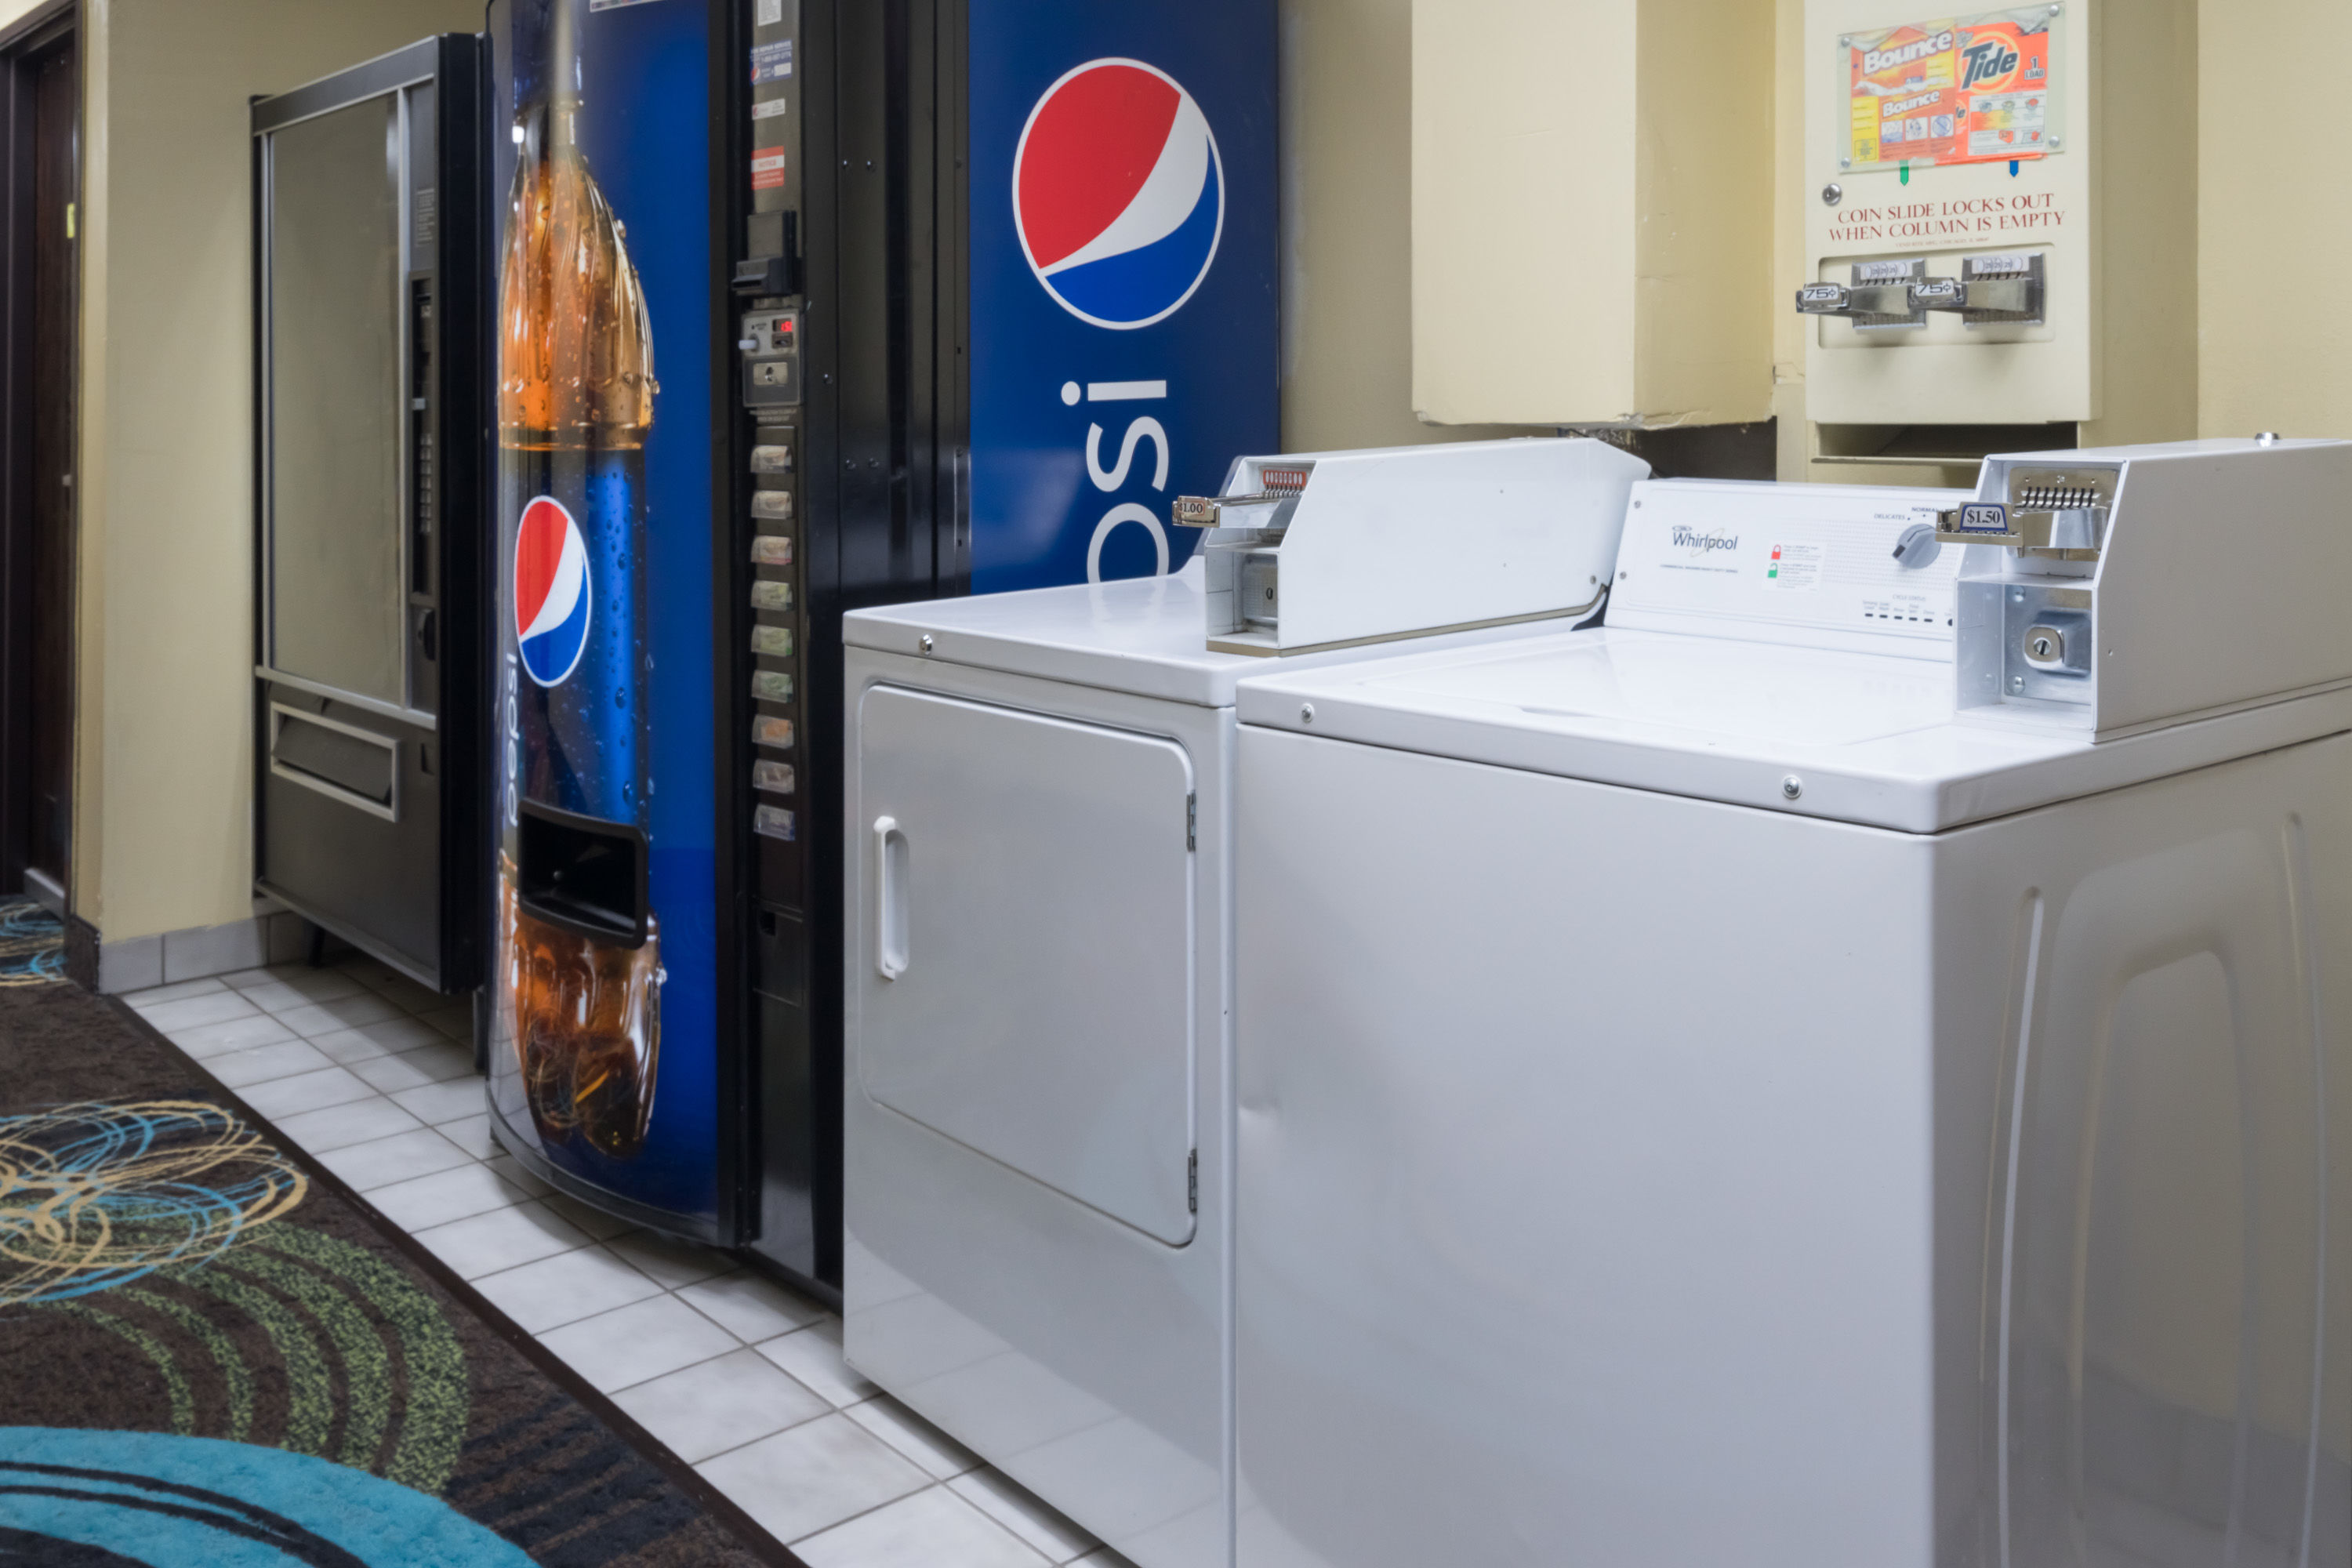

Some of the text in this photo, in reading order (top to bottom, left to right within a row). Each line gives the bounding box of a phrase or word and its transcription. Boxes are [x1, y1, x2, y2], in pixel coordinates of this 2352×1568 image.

[1864, 31, 1953, 75] Bounce
[2031, 56, 2038, 69] 1
[1961, 40, 2019, 91] Tide
[2024, 67, 2045, 79] LOAD
[1882, 90, 1940, 118] Bounce
[1838, 193, 2054, 224] COIN SLIDE LOCKS OUT
[1829, 211, 2065, 241] WHEN COLUMN IS EMPTY
[1806, 288, 1837, 299] 75¢
[1917, 282, 1951, 294] 75¢
[1966, 510, 2000, 524] $1.50
[1673, 532, 1738, 553] Whirlpool
[506, 653, 520, 826] pepsi
